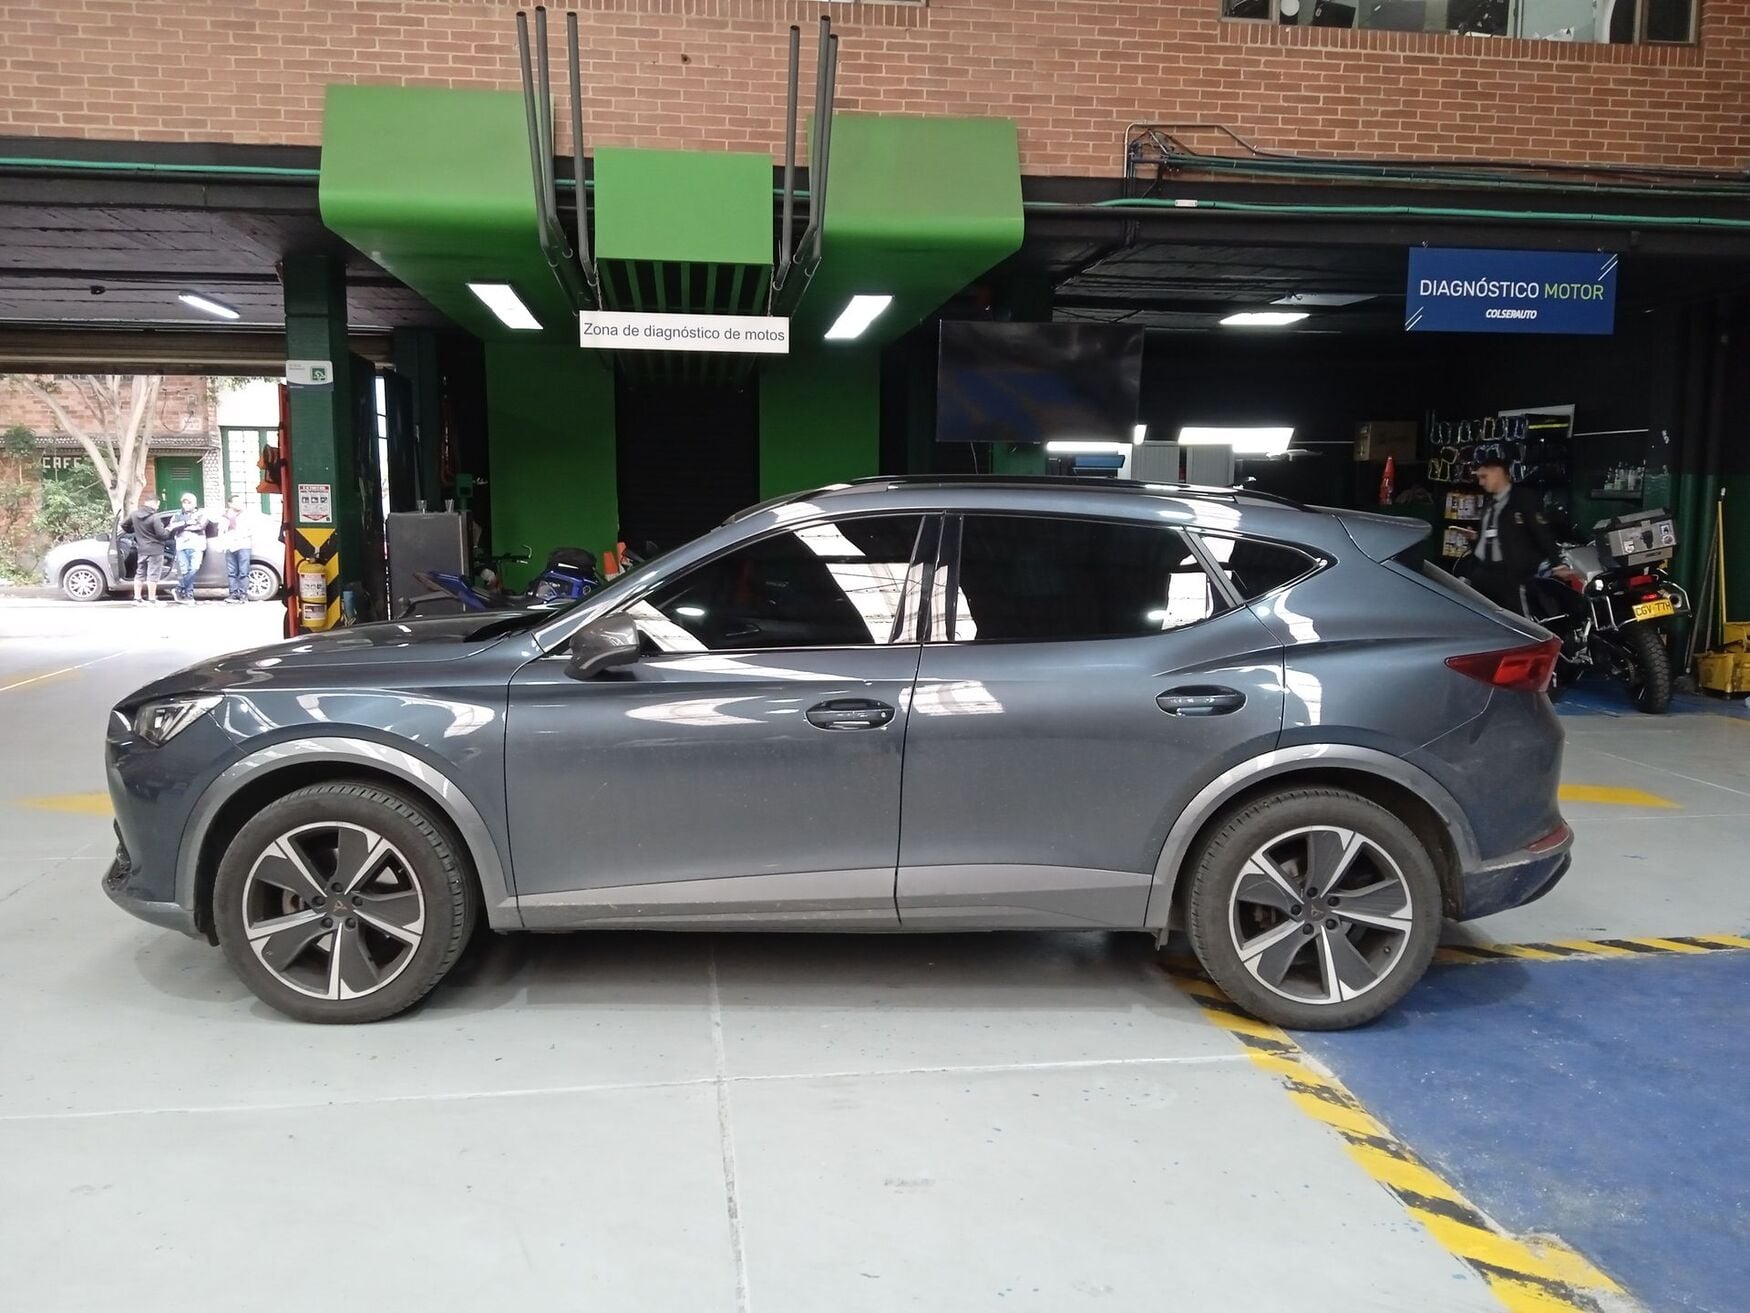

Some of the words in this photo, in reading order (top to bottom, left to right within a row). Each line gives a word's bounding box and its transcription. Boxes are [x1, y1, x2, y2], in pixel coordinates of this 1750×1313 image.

[1419, 277, 1539, 298] DIAGNÓSTICO
[1544, 283, 1604, 300] MOTOR
[1485, 308, 1538, 320] COLSERAUTO
[583, 322, 618, 336] Zona
[623, 323, 640, 337] de
[643, 324, 720, 341] diagnóstico
[724, 327, 741, 340] de
[745, 328, 785, 341] motos
[1635, 605, 1653, 617] CGV
